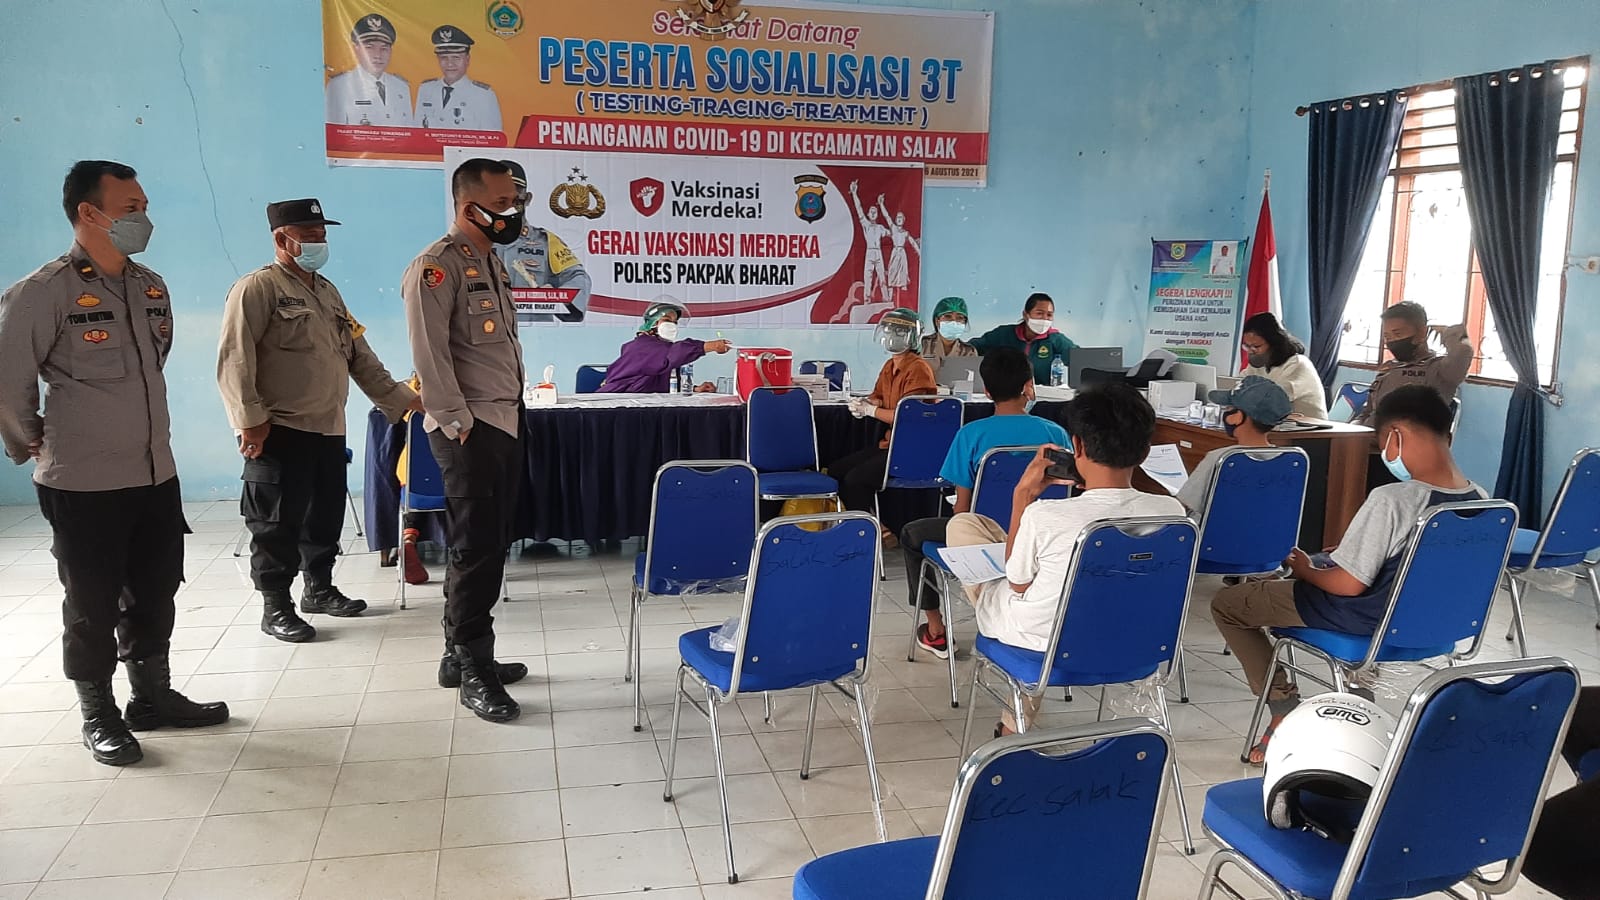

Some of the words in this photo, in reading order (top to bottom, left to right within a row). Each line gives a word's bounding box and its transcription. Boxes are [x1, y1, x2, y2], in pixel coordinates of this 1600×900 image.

[767, 18, 860, 49] Datang
[539, 37, 696, 90] PESERTA
[706, 46, 911, 100] SOSIALISASI
[920, 58, 963, 103] 3T
[538, 120, 668, 150] PENANGANAN
[766, 131, 785, 154] DI
[790, 132, 897, 158] KECAMATAN
[902, 136, 958, 160] SALAK
[930, 167, 960, 177] AGUSTUS
[961, 168, 979, 177] 2021
[671, 180, 760, 200] Vaksinasi
[671, 200, 763, 219] Merdeka!
[518, 247, 545, 256] POLRI
[587, 229, 640, 256] GERAI
[643, 231, 734, 257] VAKSINASI
[739, 234, 821, 259] MERDEKA
[614, 261, 672, 285] POLRES
[677, 263, 735, 285] PAKPAK
[739, 264, 797, 286] BHARAT
[1156, 288, 1184, 297] SEGERA
[1185, 288, 1223, 298] LENGKAPI
